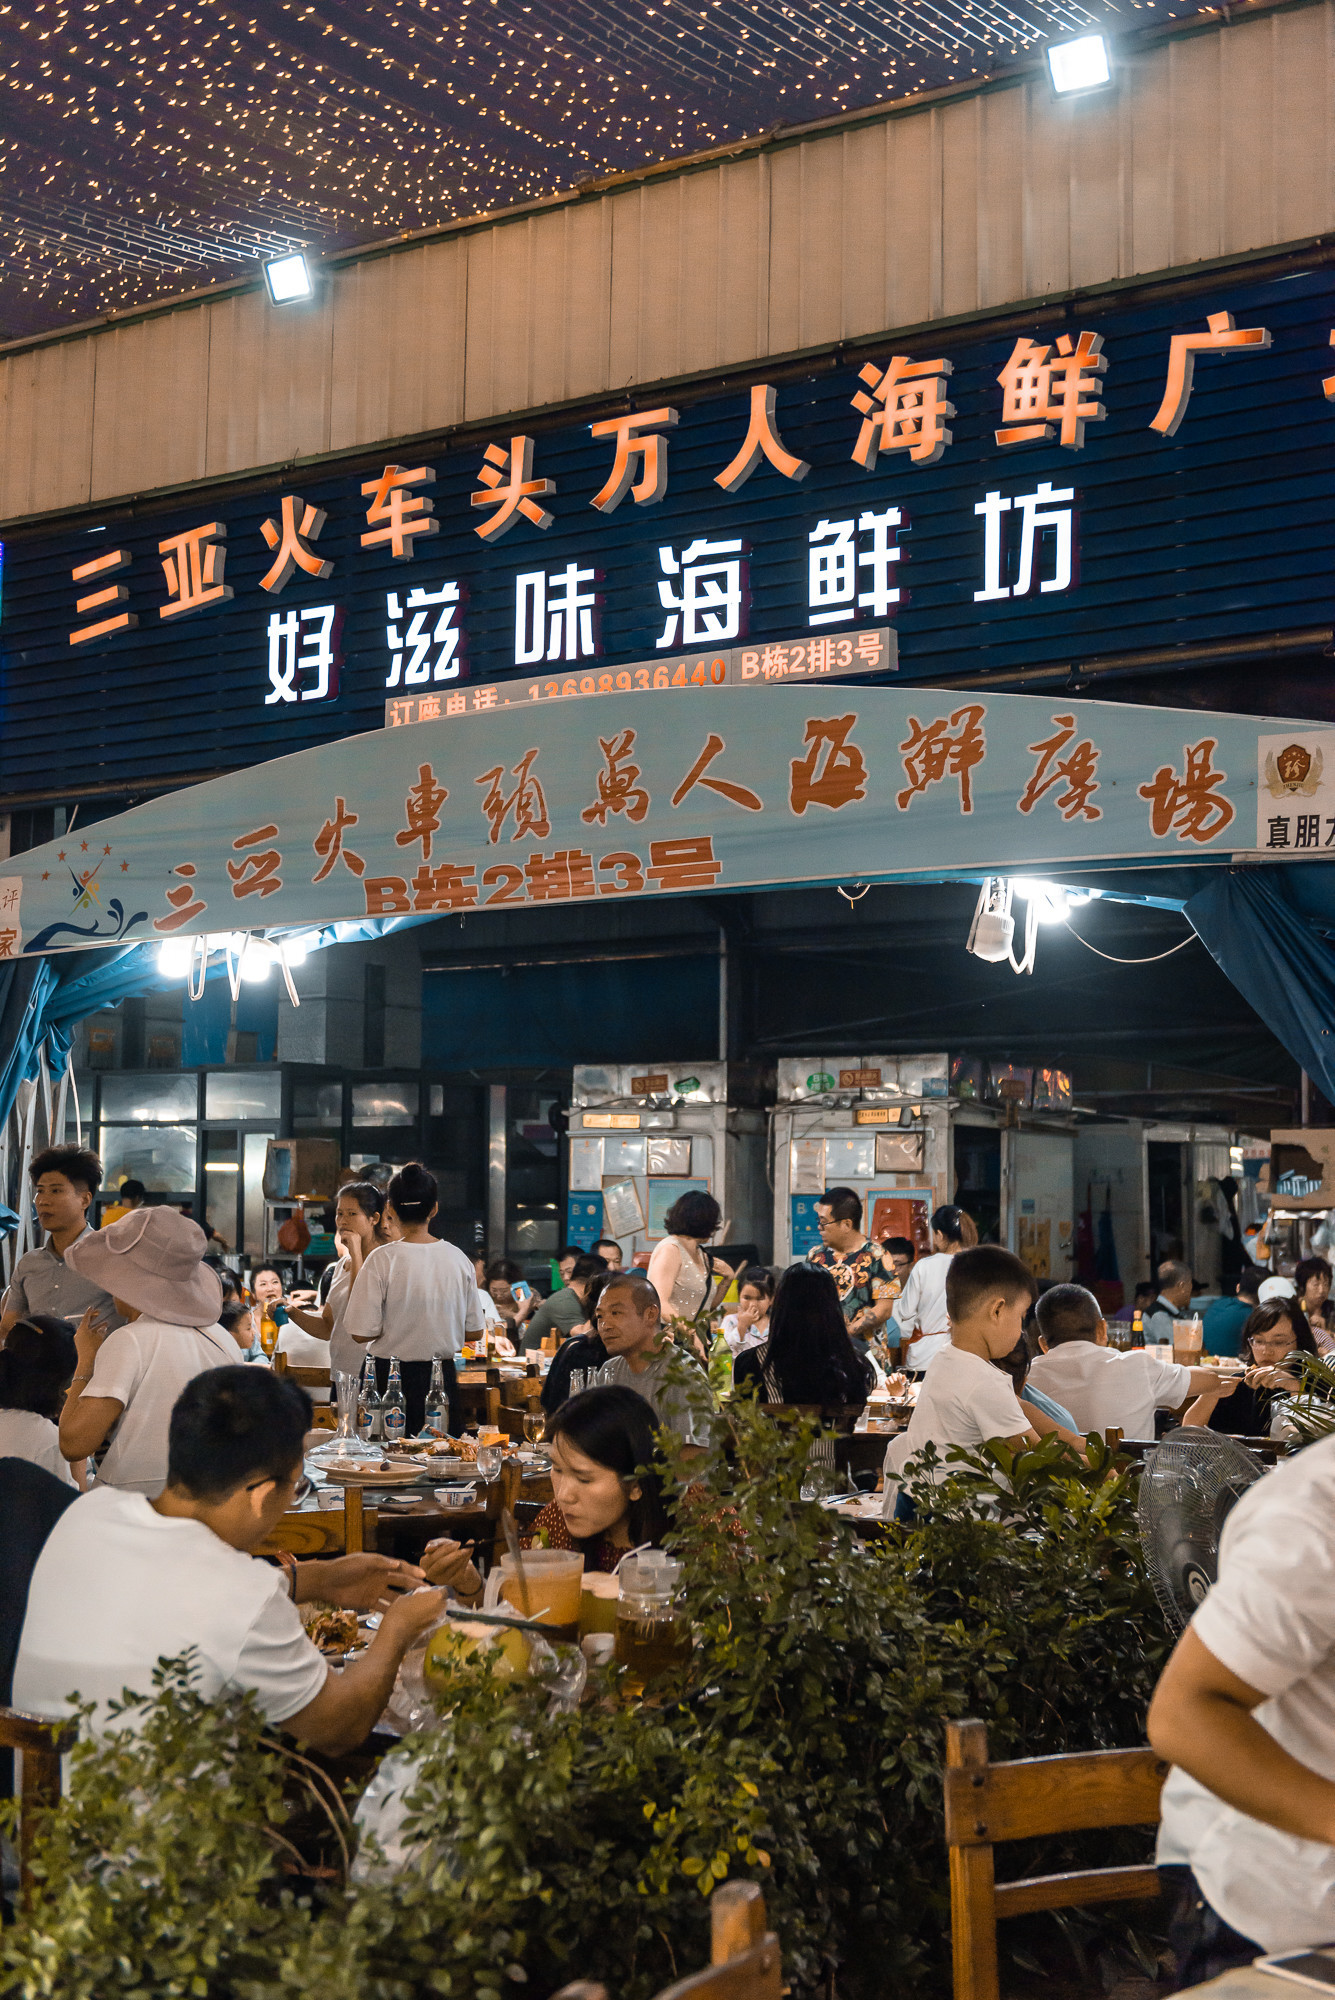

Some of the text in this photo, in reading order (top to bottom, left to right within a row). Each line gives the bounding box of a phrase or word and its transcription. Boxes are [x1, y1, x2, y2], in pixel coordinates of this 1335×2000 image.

[69, 311, 1335, 645] 三亚火车头万人海鲜广
[265, 482, 1074, 704] 好滋味海鲜坊
[741, 632, 884, 680] B栋2排3号
[364, 836, 722, 916] B栋2排3号
